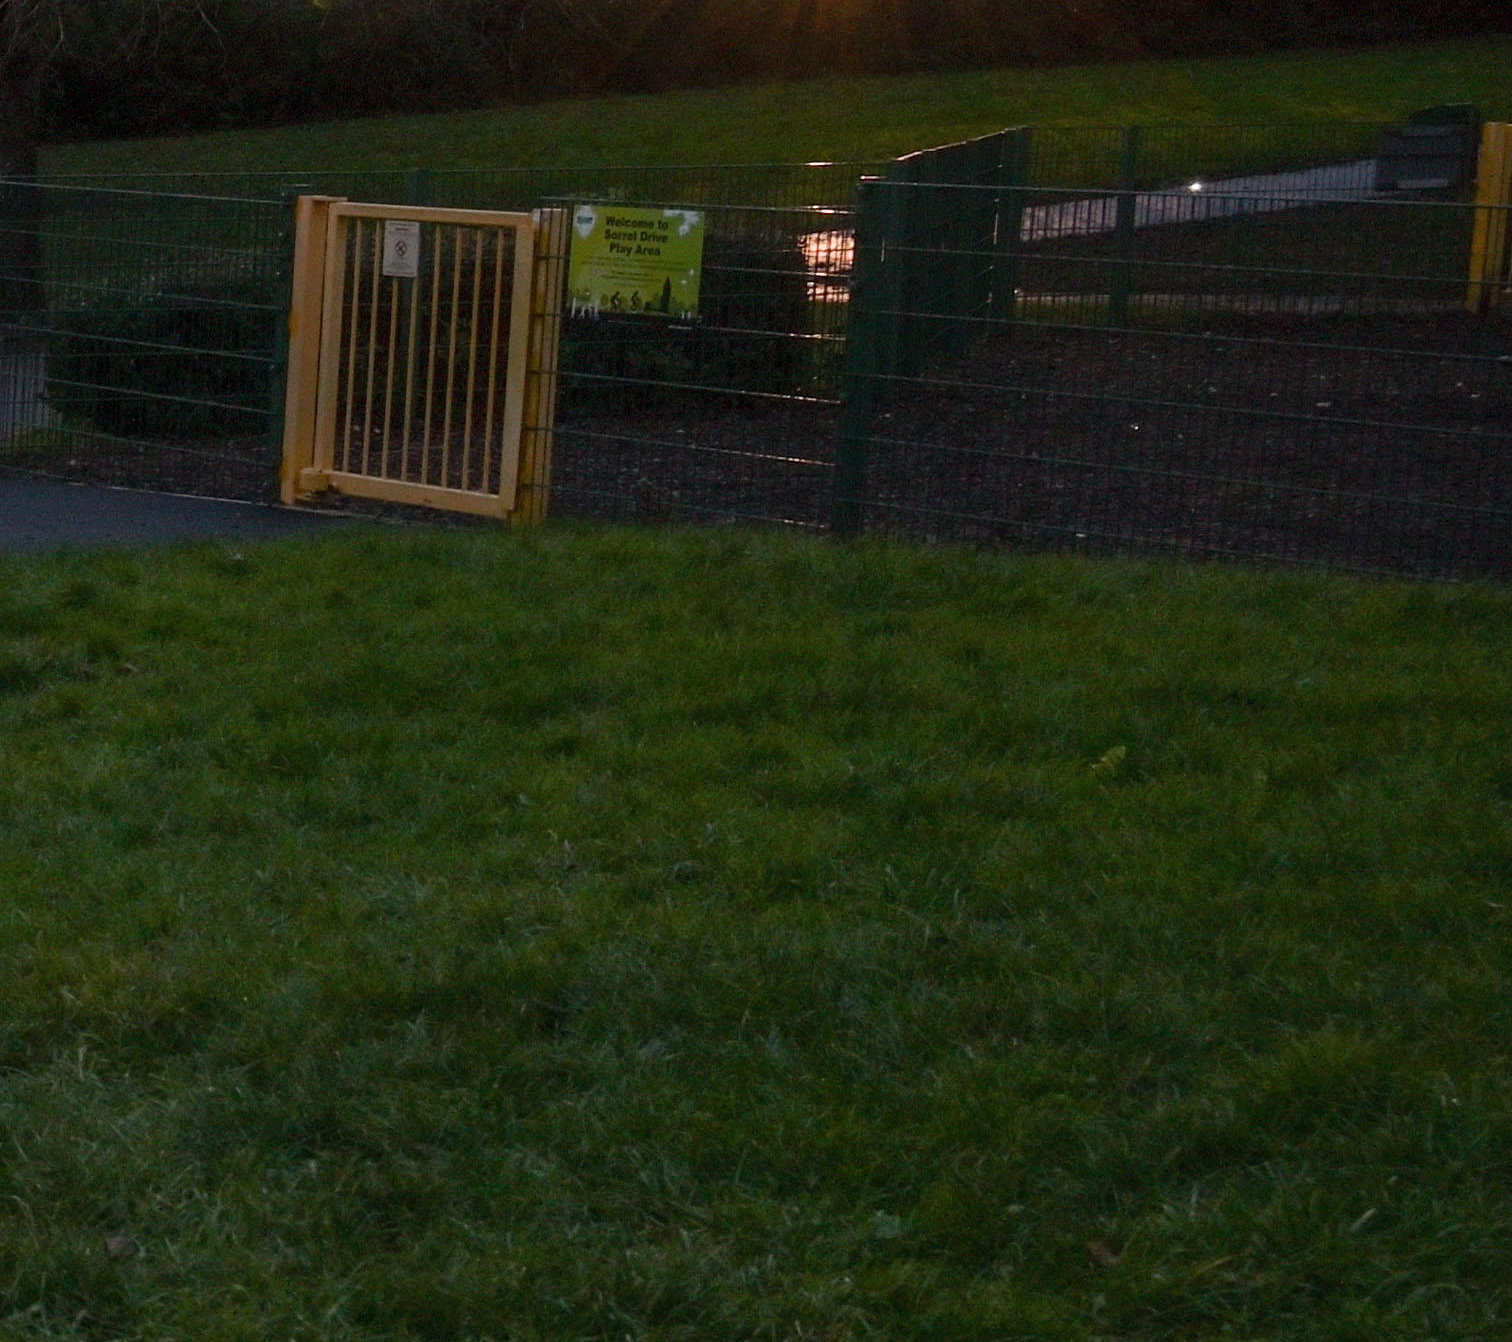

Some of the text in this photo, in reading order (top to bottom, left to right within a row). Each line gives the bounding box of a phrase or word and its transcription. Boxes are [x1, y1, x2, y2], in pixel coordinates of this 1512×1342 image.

[606, 216, 655, 228] Welcome
[657, 219, 669, 229] to
[640, 231, 668, 243] Drive
[609, 243, 661, 256] Play Area
